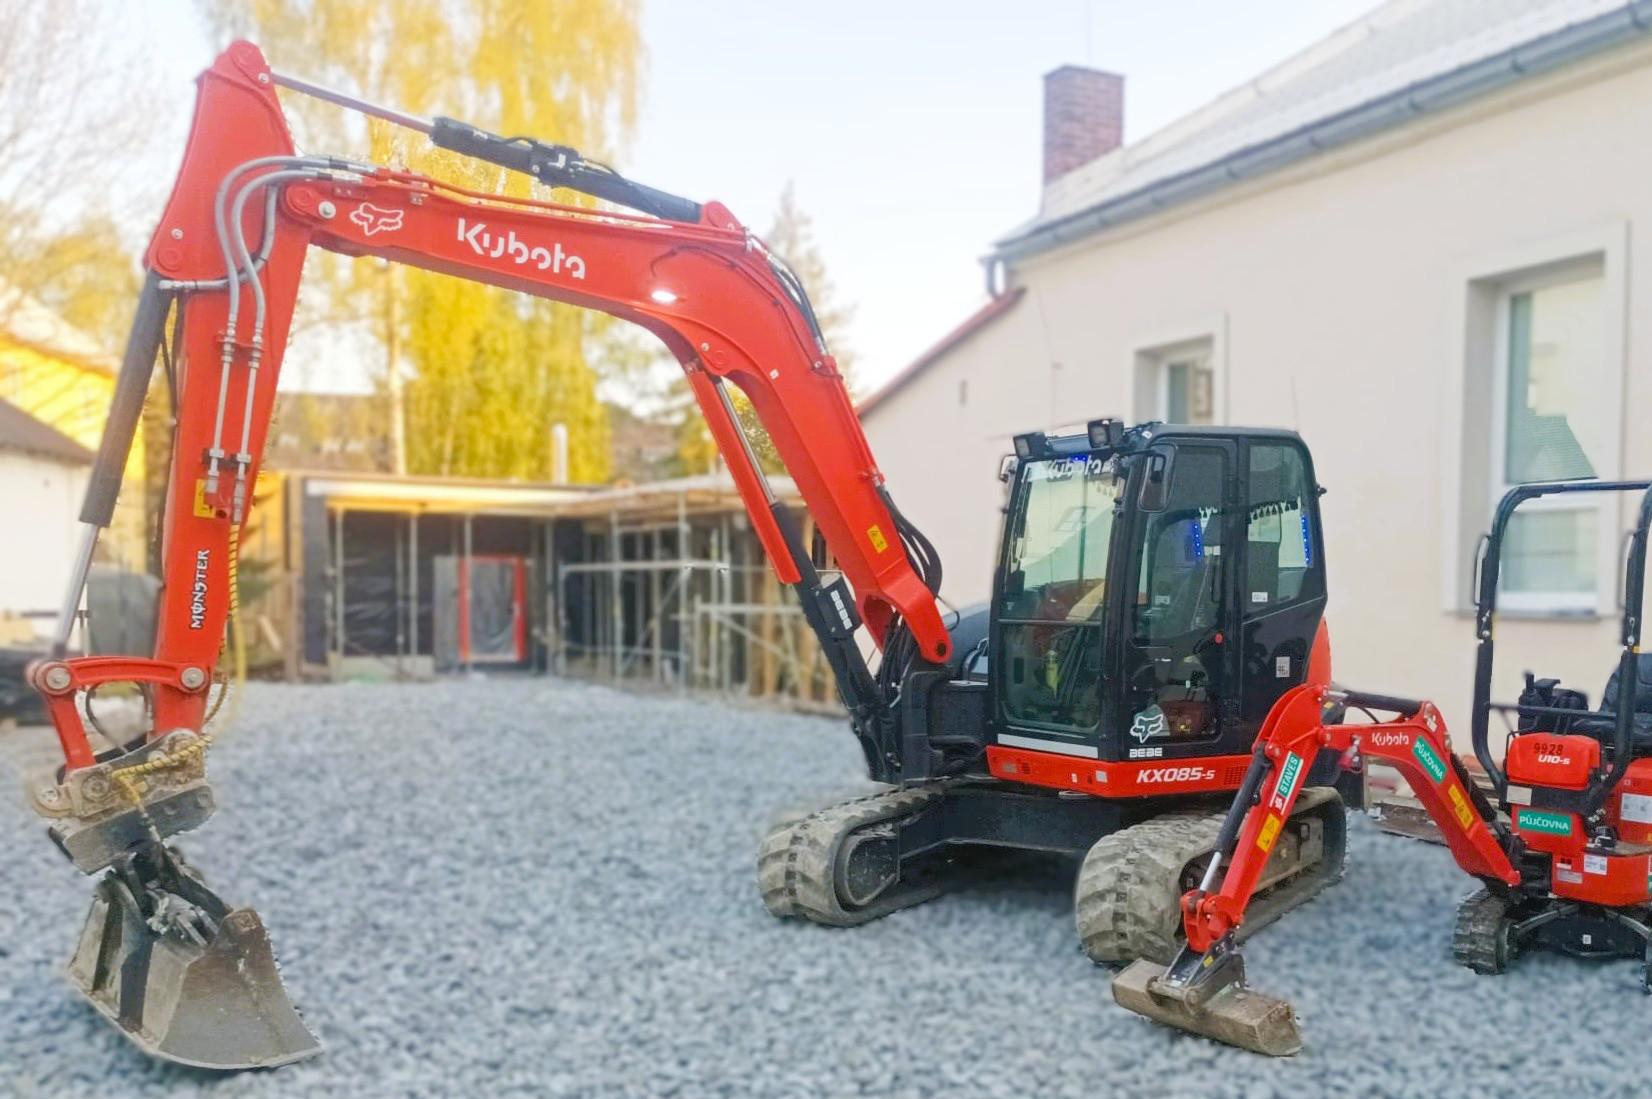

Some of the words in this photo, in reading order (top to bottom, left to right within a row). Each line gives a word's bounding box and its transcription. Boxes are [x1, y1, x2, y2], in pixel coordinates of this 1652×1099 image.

[457, 217, 586, 280] Kubota
[1372, 732, 1409, 746] Kubota
[1533, 743, 1563, 755] 9928
[1281, 756, 1298, 794] STAVES
[1519, 813, 1569, 830] PŮJČOVNA
